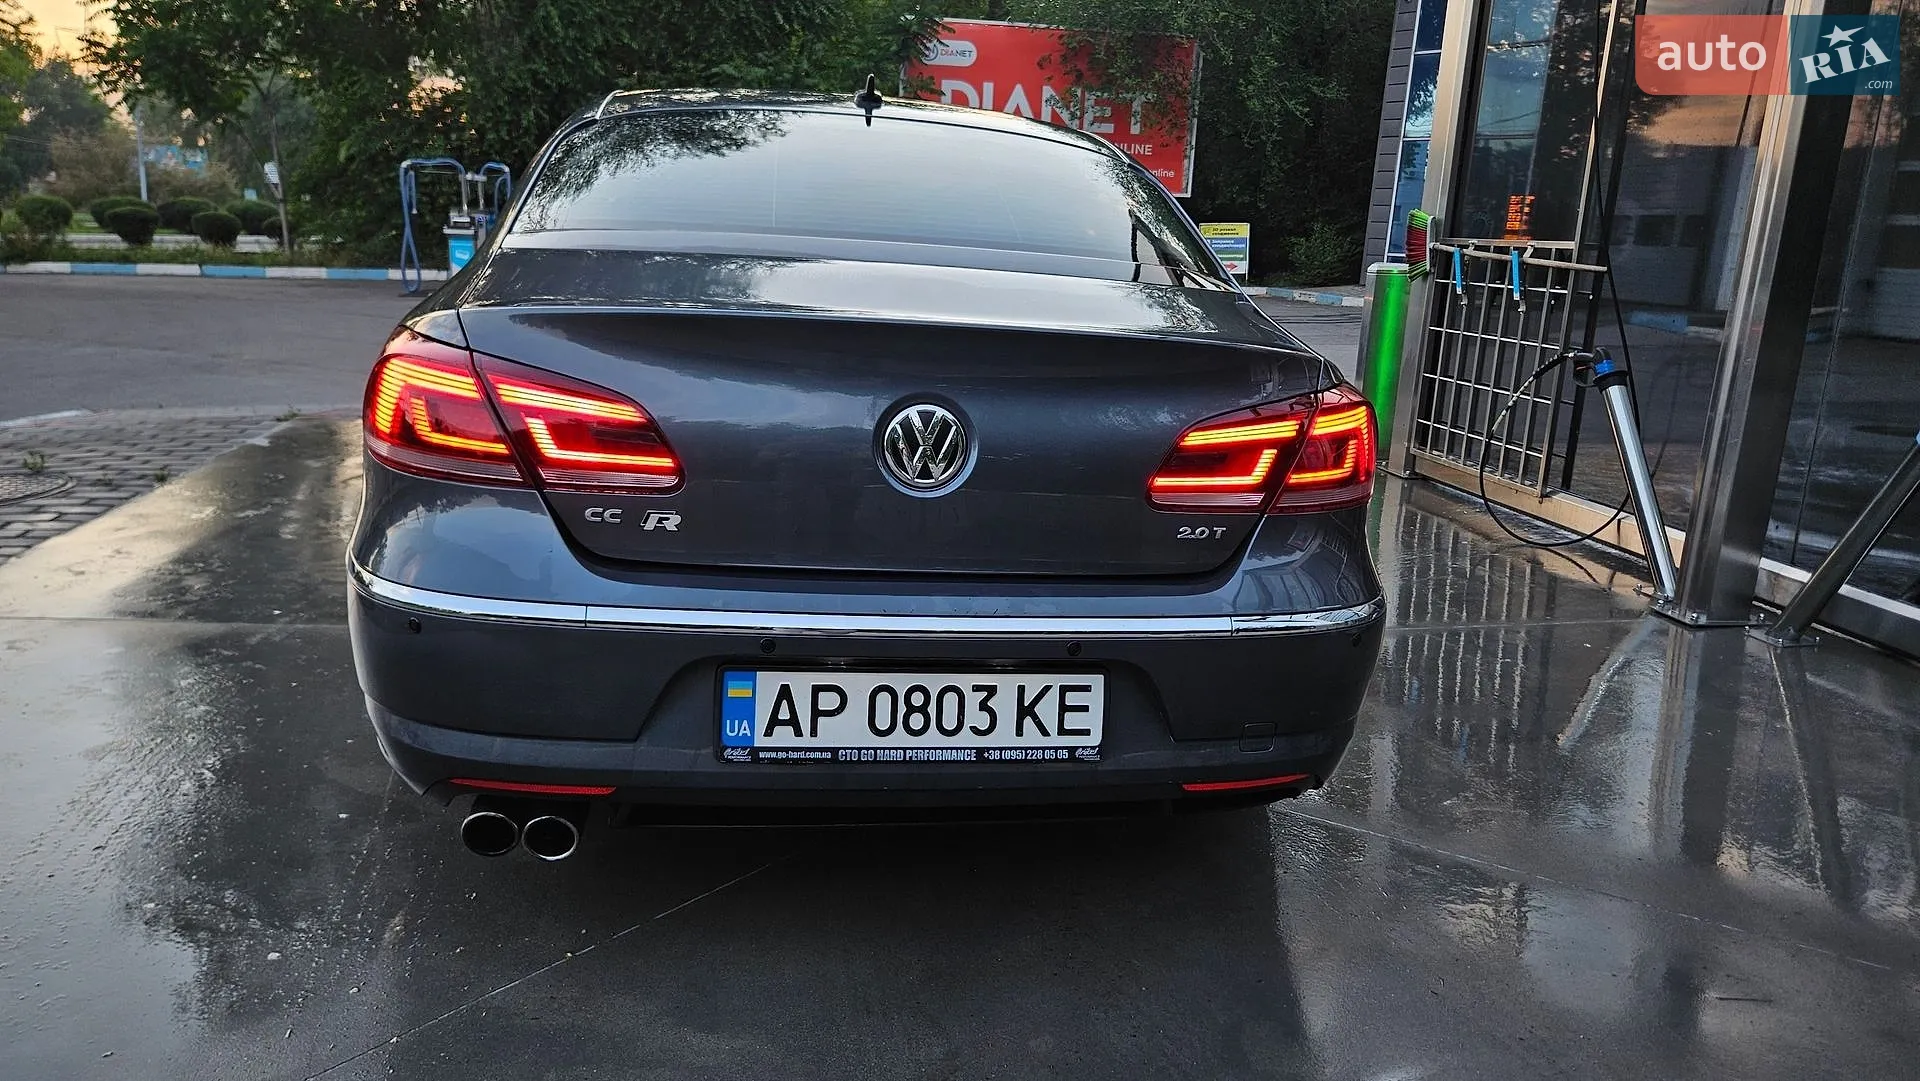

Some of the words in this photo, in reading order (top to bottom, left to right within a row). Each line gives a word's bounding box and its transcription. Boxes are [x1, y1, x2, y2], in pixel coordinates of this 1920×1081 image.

[940, 48, 973, 58] DIANET
[941, 79, 1157, 135] DIANET
[1150, 168, 1175, 178] nline
[584, 507, 623, 523] CC
[640, 510, 682, 531] R
[762, 683, 848, 738] AP
[867, 683, 999, 738] 0803
[1015, 684, 1093, 738] KE
[726, 719, 751, 737] UA
[759, 750, 832, 760] www.go-hard.com.ua
[860, 749, 875, 761] GO
[876, 749, 904, 761] HARD
[905, 749, 977, 761] PERFORMANCE
[983, 749, 1001, 760] +38
[1001, 749, 1025, 760] (095)
[1026, 749, 1043, 760] 228
[1044, 749, 1056, 759] 05
[1057, 749, 1069, 759] 05
